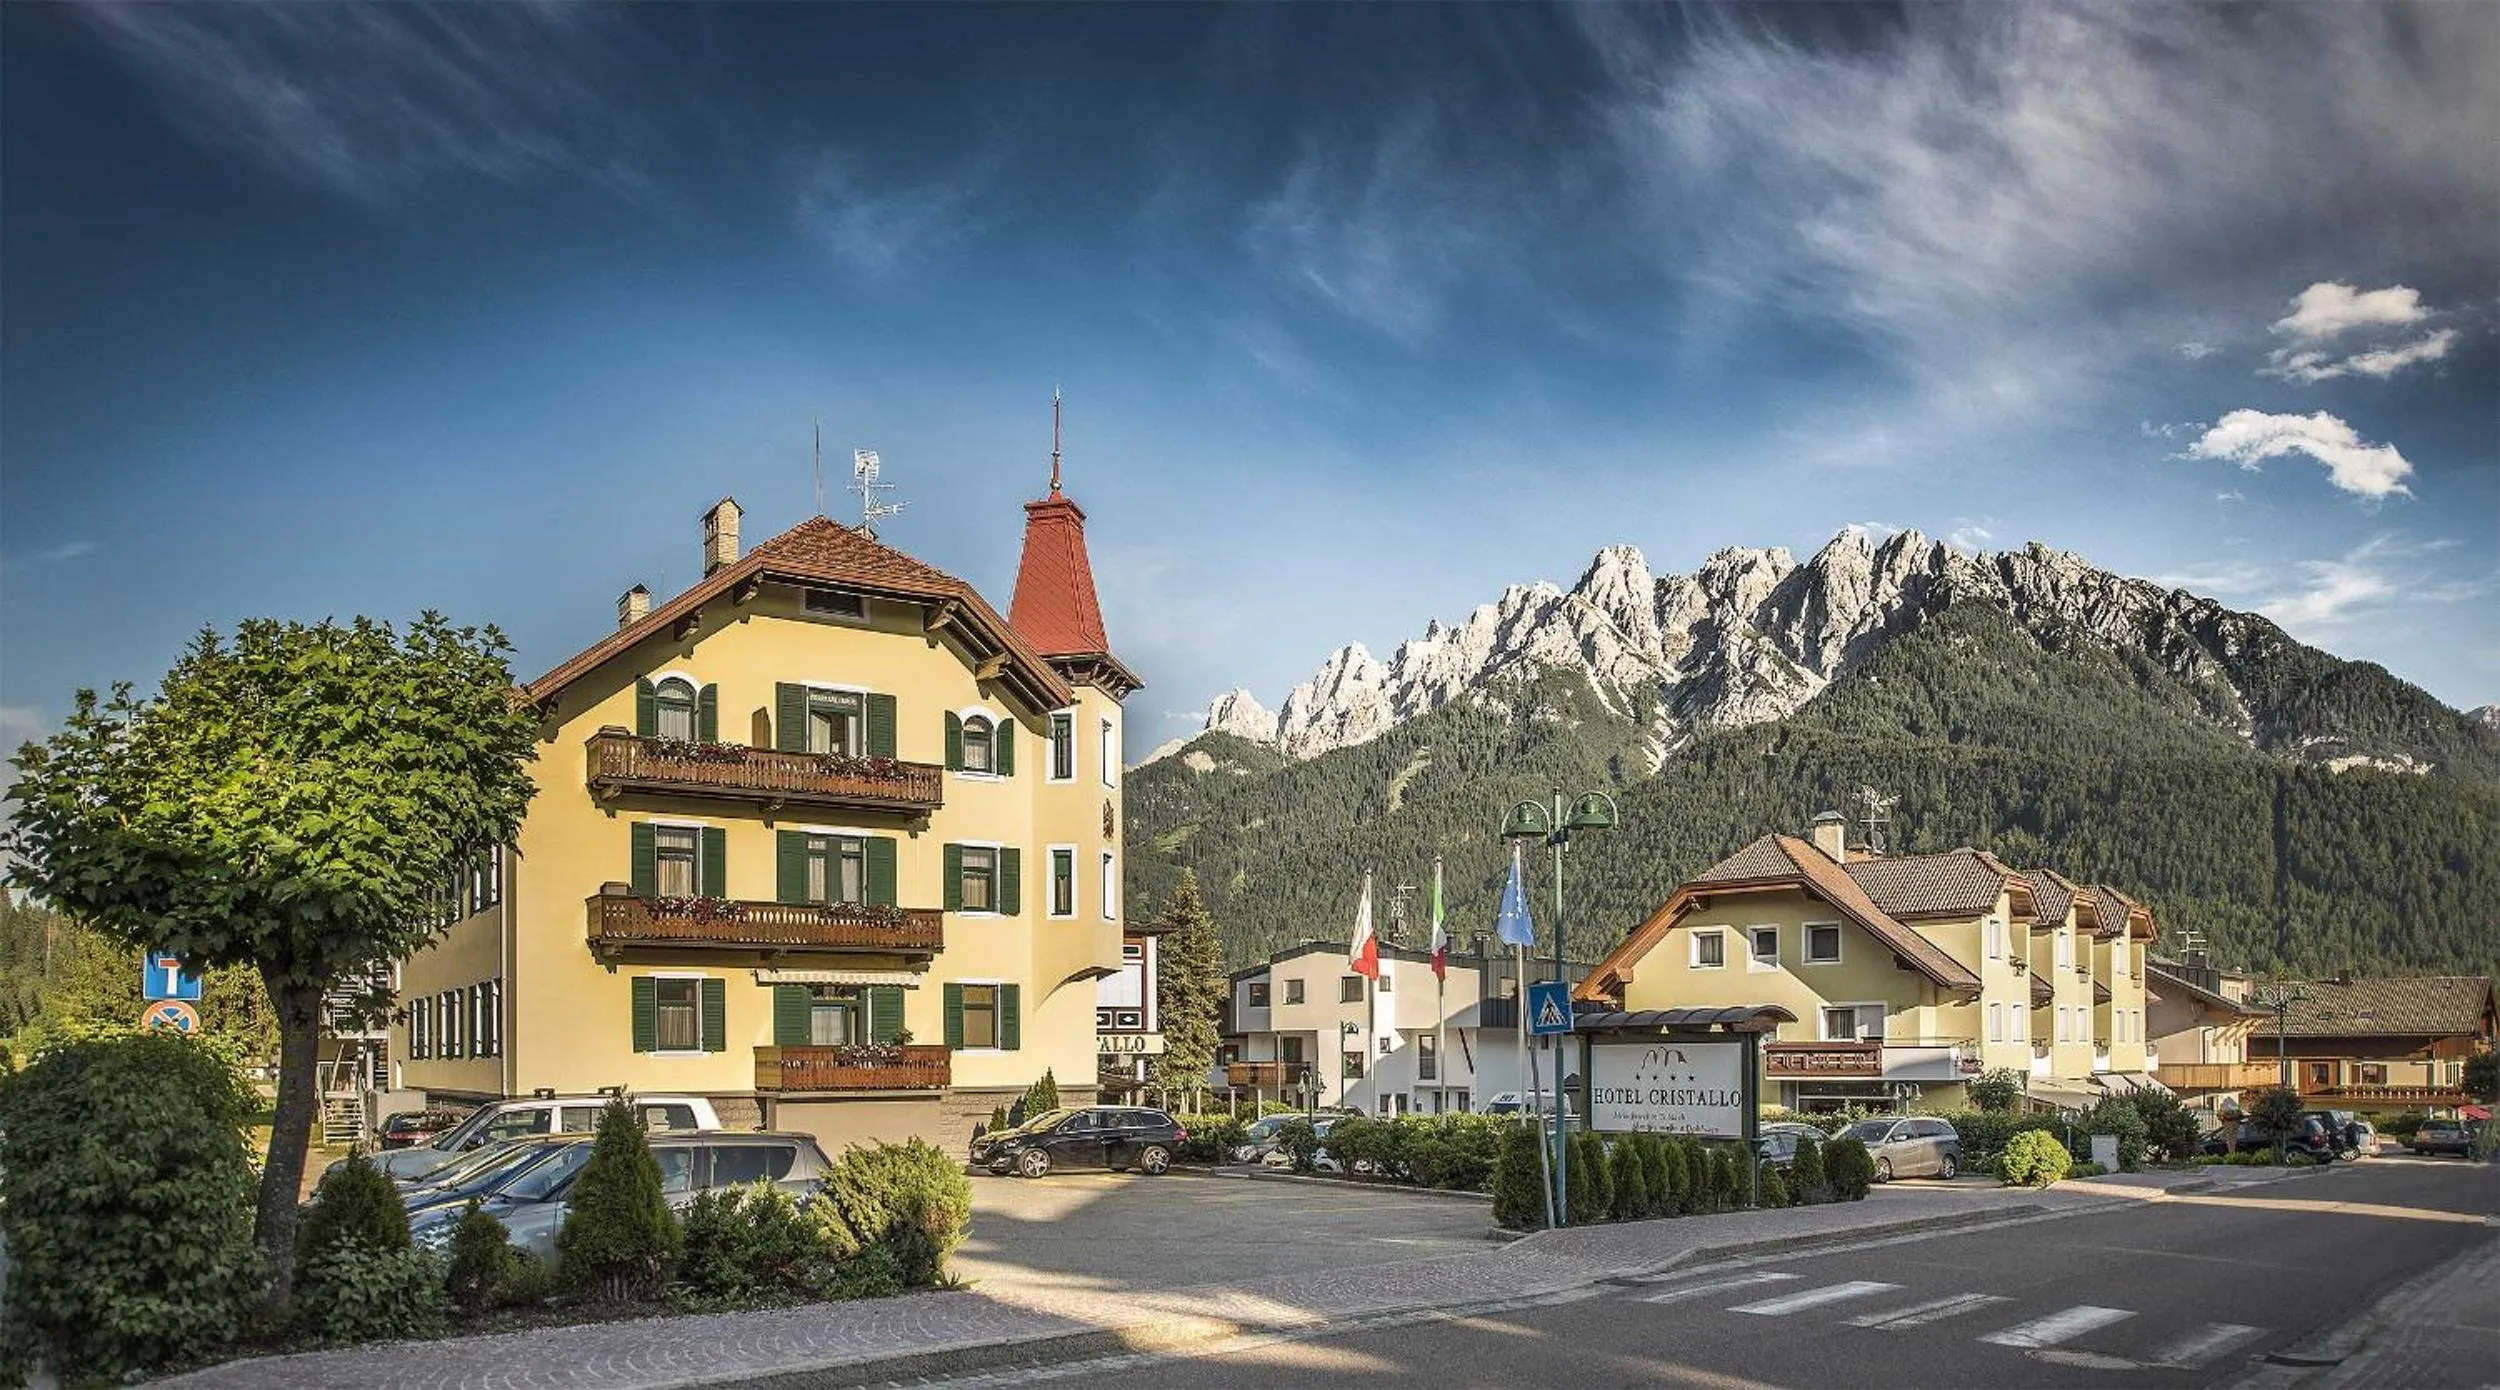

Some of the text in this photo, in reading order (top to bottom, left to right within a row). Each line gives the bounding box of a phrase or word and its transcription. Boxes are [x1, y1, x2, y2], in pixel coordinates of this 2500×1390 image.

[1097, 1035, 1146, 1052] ALLO
[1594, 1087, 1741, 1108] HOTEL CRISTALLO
